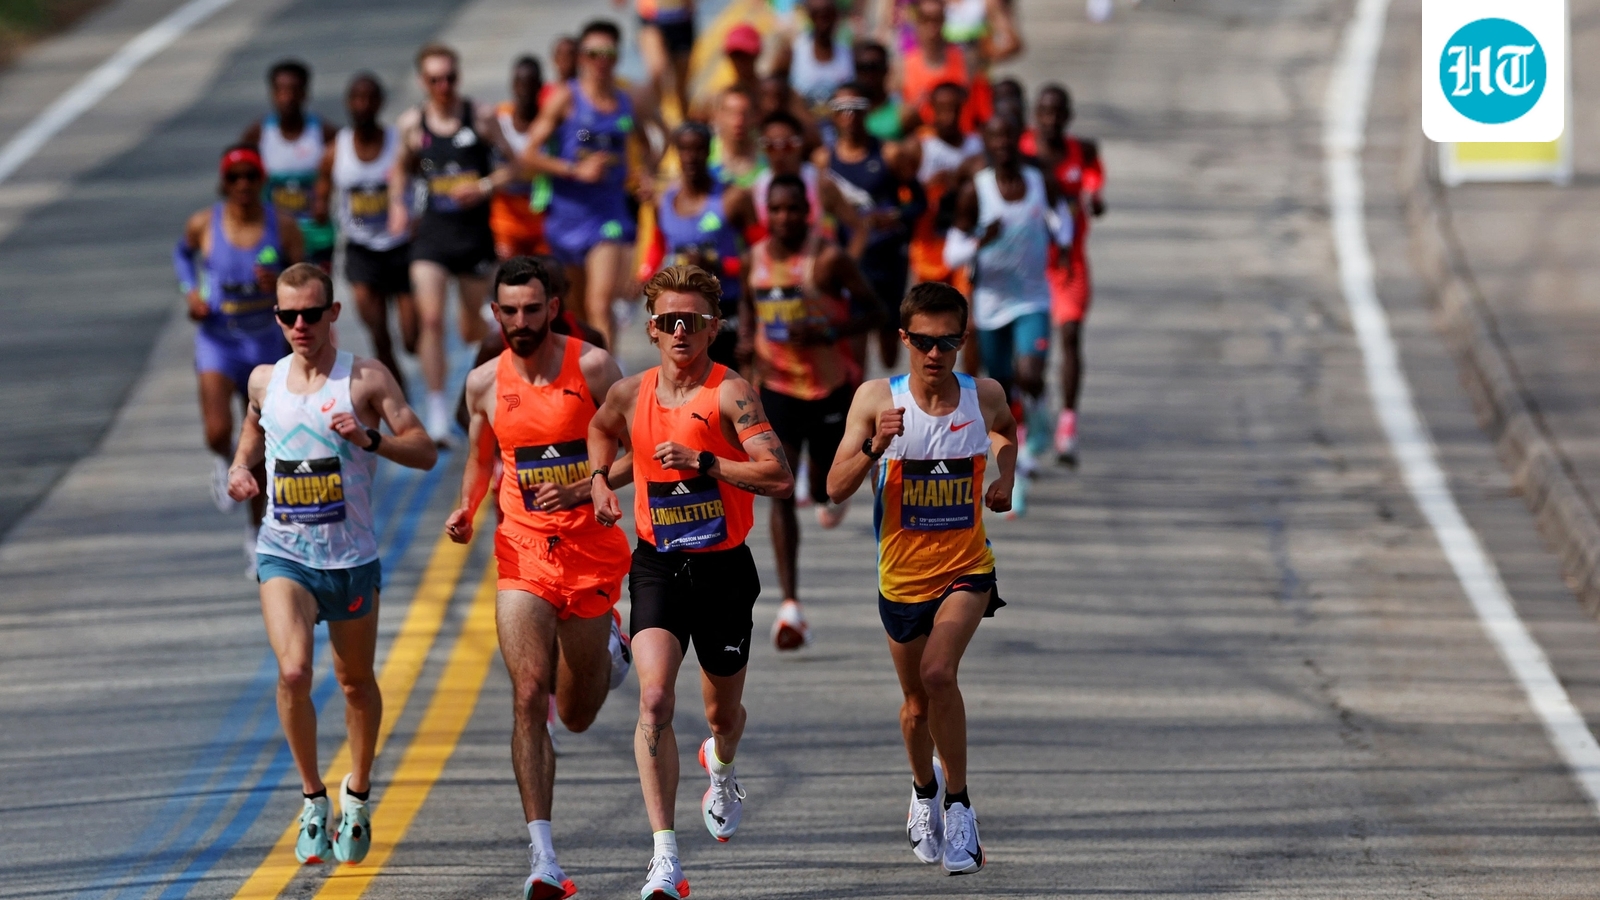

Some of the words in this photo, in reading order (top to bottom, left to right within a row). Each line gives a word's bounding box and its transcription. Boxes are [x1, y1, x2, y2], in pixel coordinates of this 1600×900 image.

[274, 473, 343, 506] YOUNG
[517, 460, 592, 490] TIERNAN
[902, 476, 974, 507] MANTZ
[650, 499, 725, 526] LINKLETTER
